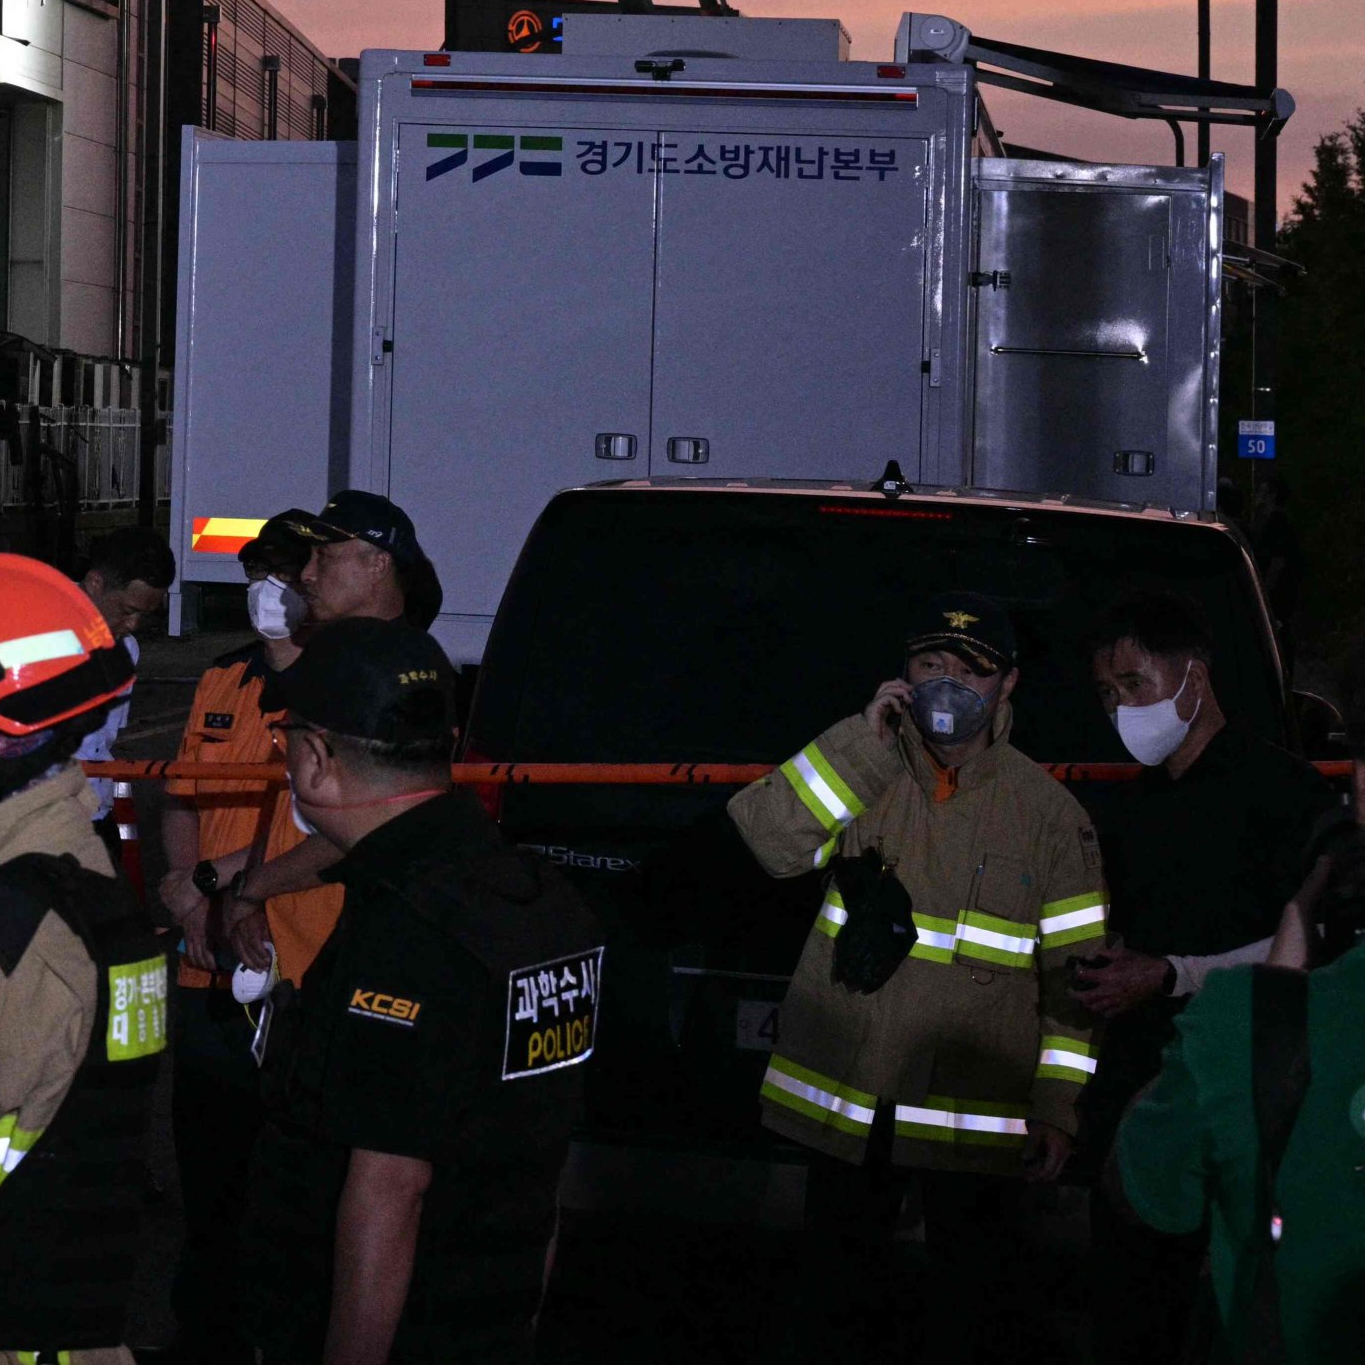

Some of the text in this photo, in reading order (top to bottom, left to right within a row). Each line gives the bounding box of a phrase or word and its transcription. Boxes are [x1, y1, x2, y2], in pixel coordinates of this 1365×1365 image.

[575, 138, 900, 183] 경기도소방재난본부
[1247, 439, 1266, 454] 50
[350, 988, 421, 1021] KCSI
[514, 958, 596, 1024] 과학수사
